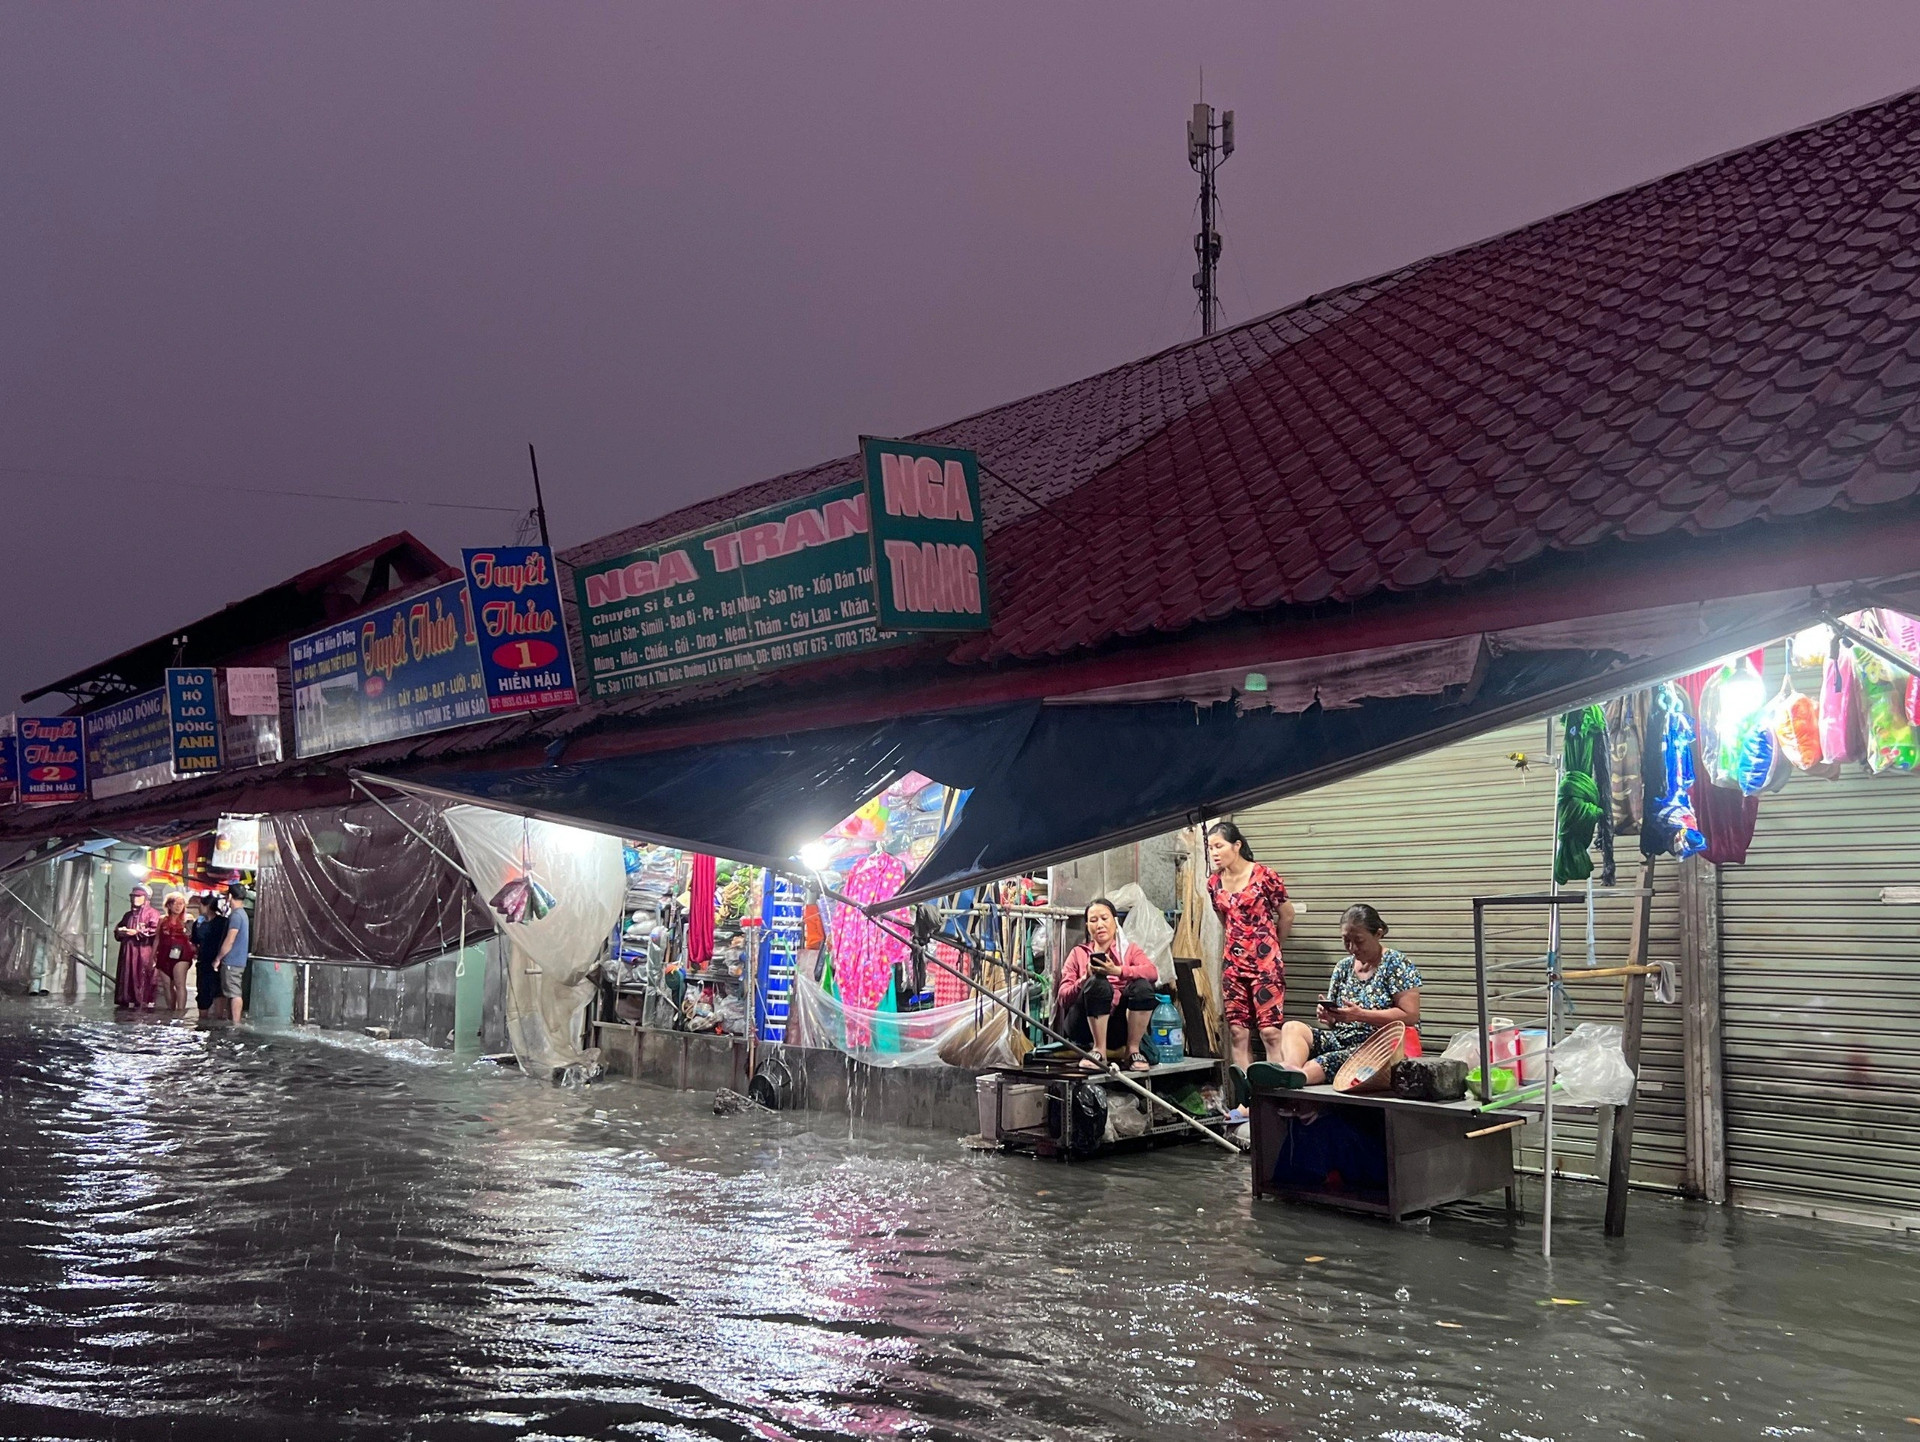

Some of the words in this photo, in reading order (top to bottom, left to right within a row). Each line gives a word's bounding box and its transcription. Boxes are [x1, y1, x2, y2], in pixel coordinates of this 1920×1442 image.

[880, 452, 974, 522] NGA
[471, 552, 549, 594] Tuyết
[585, 550, 699, 607] NGA
[884, 539, 981, 614] TRANG
[592, 606, 640, 626] Chuyên
[663, 596, 674, 608] &
[670, 614, 686, 630] Bao
[702, 606, 714, 621] Pe
[788, 583, 804, 600] Tre
[812, 573, 832, 595] Xốp
[834, 570, 855, 590] Dán
[482, 599, 557, 637] Thảo
[644, 641, 668, 660] Chiếu
[696, 633, 717, 650] Drap
[754, 616, 782, 637] Thảm
[790, 610, 809, 629] Cây
[811, 606, 831, 625] Lau
[840, 597, 870, 618] Khăn
[362, 611, 408, 681] Tuyết
[410, 597, 458, 662] Thảo
[771, 643, 792, 661] 0913
[834, 630, 857, 648] 0703
[859, 626, 877, 644] 752
[515, 642, 537, 668] 1
[177, 672, 204, 685] BẢO
[534, 670, 561, 690] HẬU
[182, 688, 202, 702] HỘ
[118, 707, 134, 725] LAO
[135, 697, 160, 720] ĐỘNG
[181, 706, 206, 717] LAO
[176, 720, 214, 733] ĐỘNG
[179, 736, 215, 749] ANH
[42, 766, 61, 781] 2
[179, 755, 217, 769] LINH
